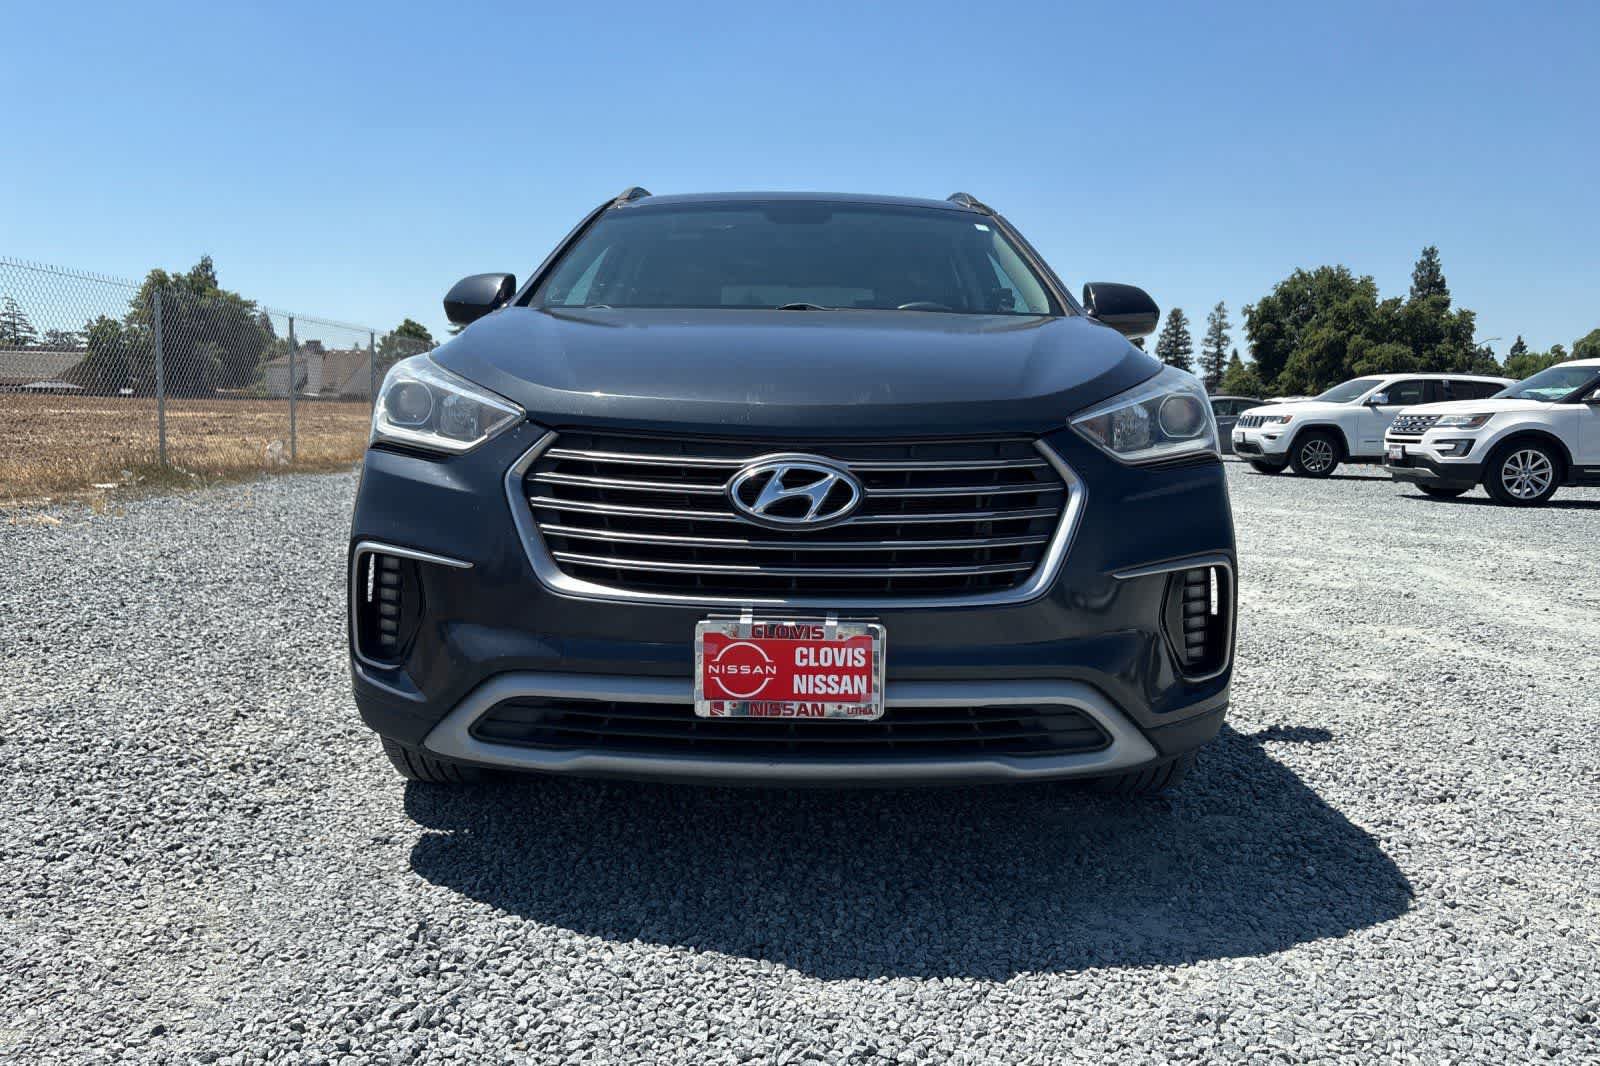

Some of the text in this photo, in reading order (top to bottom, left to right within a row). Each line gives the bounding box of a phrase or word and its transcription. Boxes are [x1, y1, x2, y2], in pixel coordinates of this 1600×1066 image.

[751, 624, 825, 639] CLOVIS
[794, 647, 866, 667] CLOVIS
[708, 664, 777, 675] NISSAN
[793, 674, 867, 695] NISSAN
[749, 702, 825, 717] NISSAN
